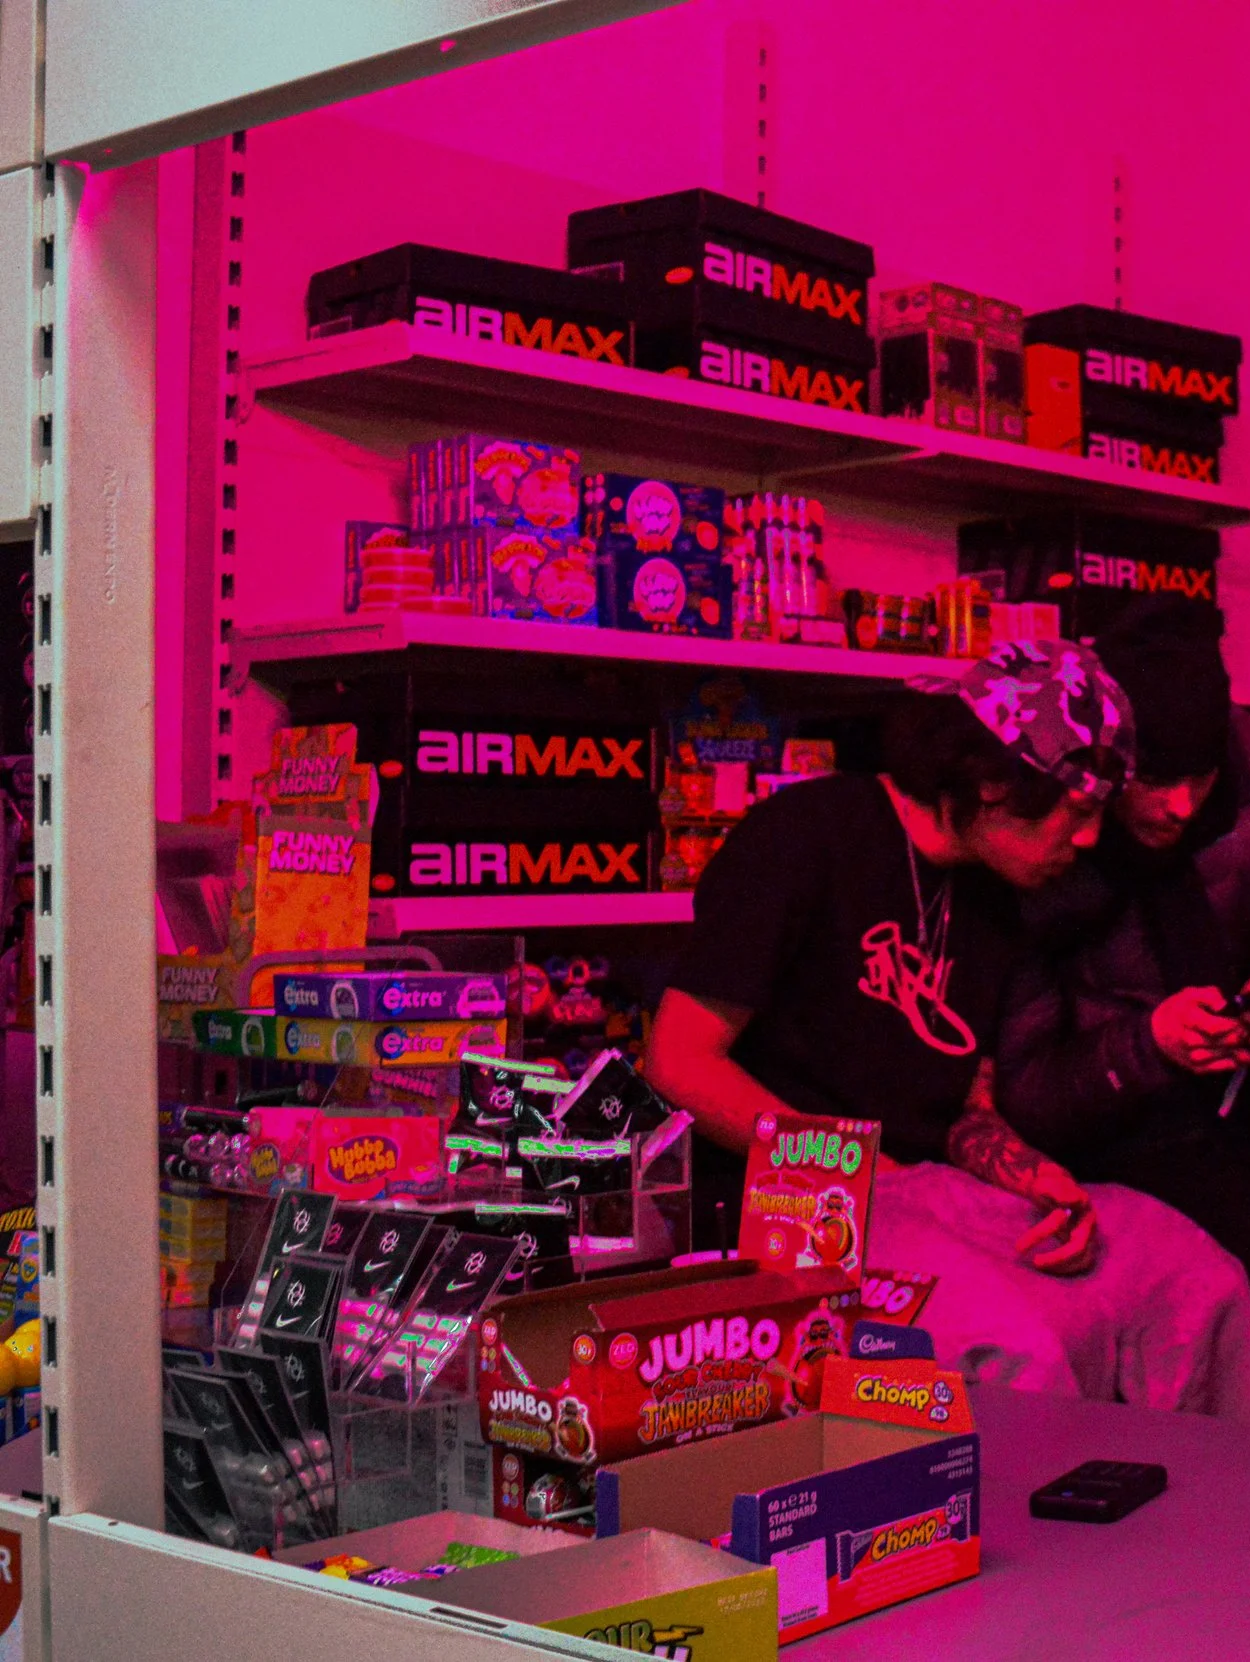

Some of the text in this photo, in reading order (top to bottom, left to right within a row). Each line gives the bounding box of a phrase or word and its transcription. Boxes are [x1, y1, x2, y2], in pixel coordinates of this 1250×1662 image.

[282, 756, 342, 776] FUNNY
[279, 775, 340, 795] MONEY
[272, 831, 355, 855] FUNNY
[270, 851, 355, 875] MONEY
[161, 966, 220, 984] FUNNY
[284, 984, 319, 1007] extra
[383, 987, 442, 1010] extra
[382, 1032, 445, 1054] extra
[329, 1138, 384, 1169] Hubba
[771, 1129, 863, 1175] JUMBO
[345, 1150, 396, 1181] Bubba
[638, 1315, 781, 1383] JUMBO
[489, 1389, 553, 1422] JUMBO
[638, 1381, 772, 1444] JAWBREAKER
[768, 1503, 818, 1529] STANDARD
[769, 1526, 794, 1543] BARS
